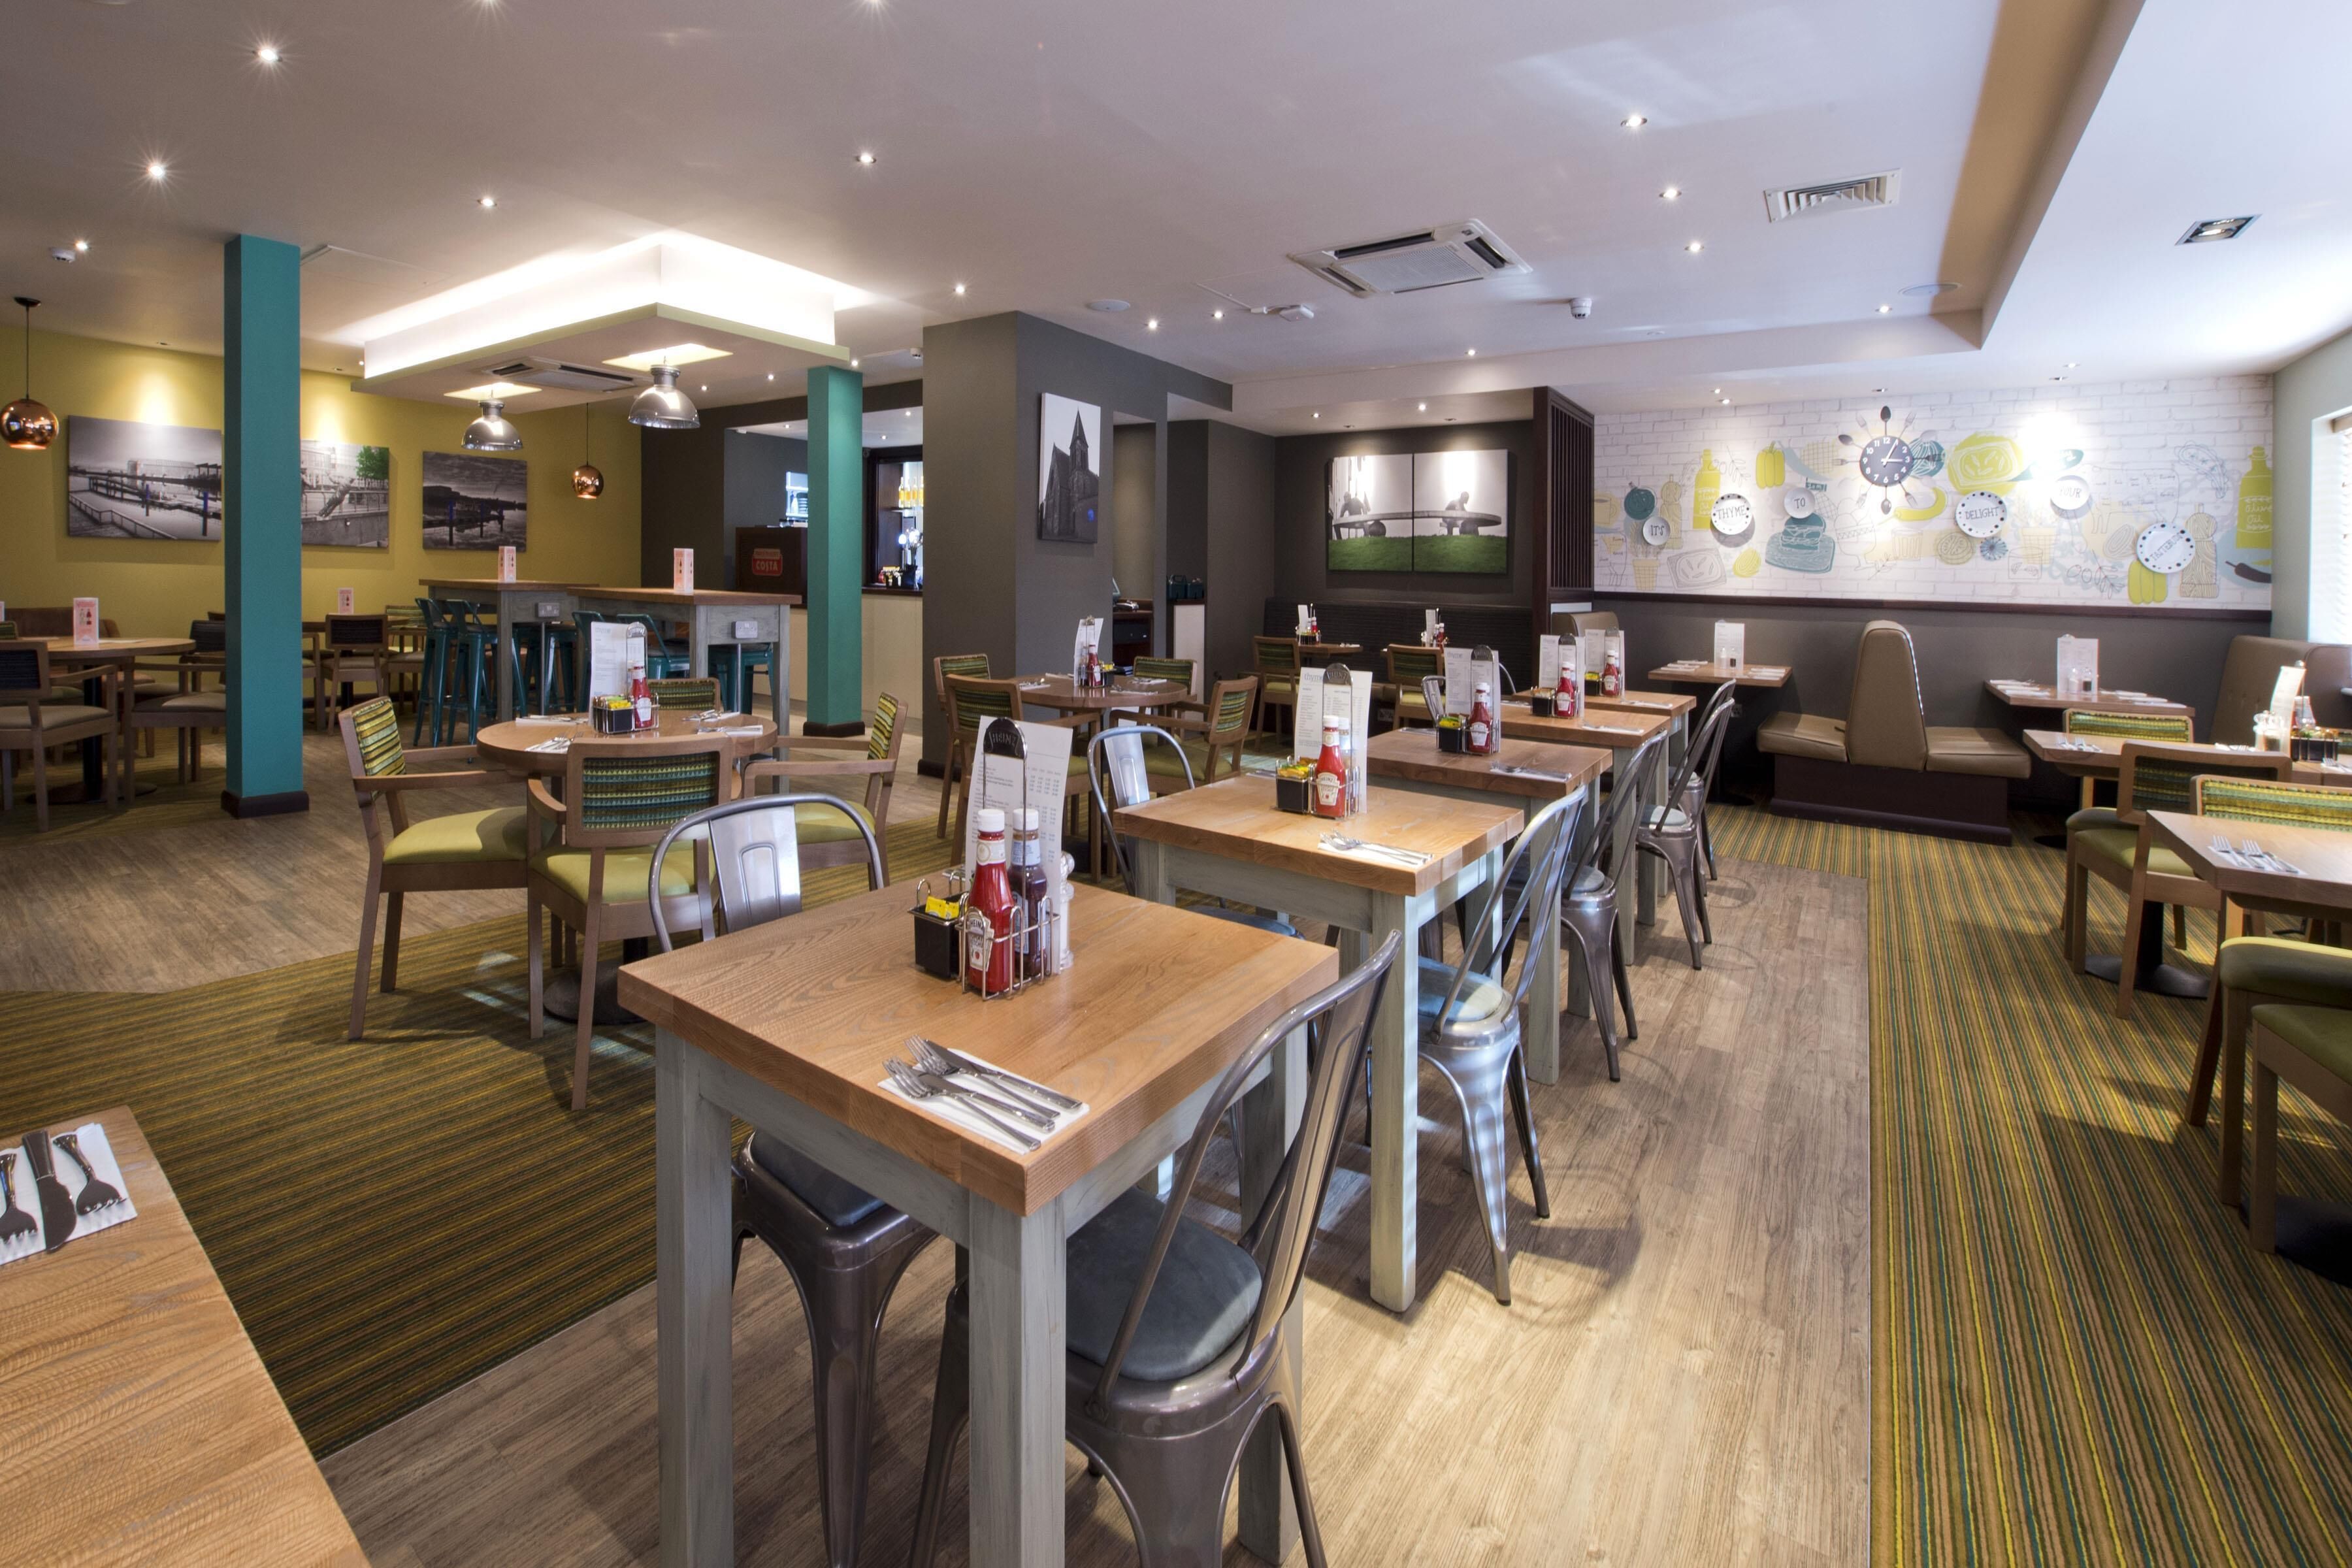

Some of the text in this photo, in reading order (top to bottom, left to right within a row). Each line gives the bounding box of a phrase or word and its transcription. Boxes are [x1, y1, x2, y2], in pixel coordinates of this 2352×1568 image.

[1794, 497, 1806, 509] TO
[1716, 504, 1747, 520] THYME
[1965, 506, 2000, 520] DELIGHT
[756, 560, 778, 572] COSTA
[992, 732, 1018, 747] HEINZ
